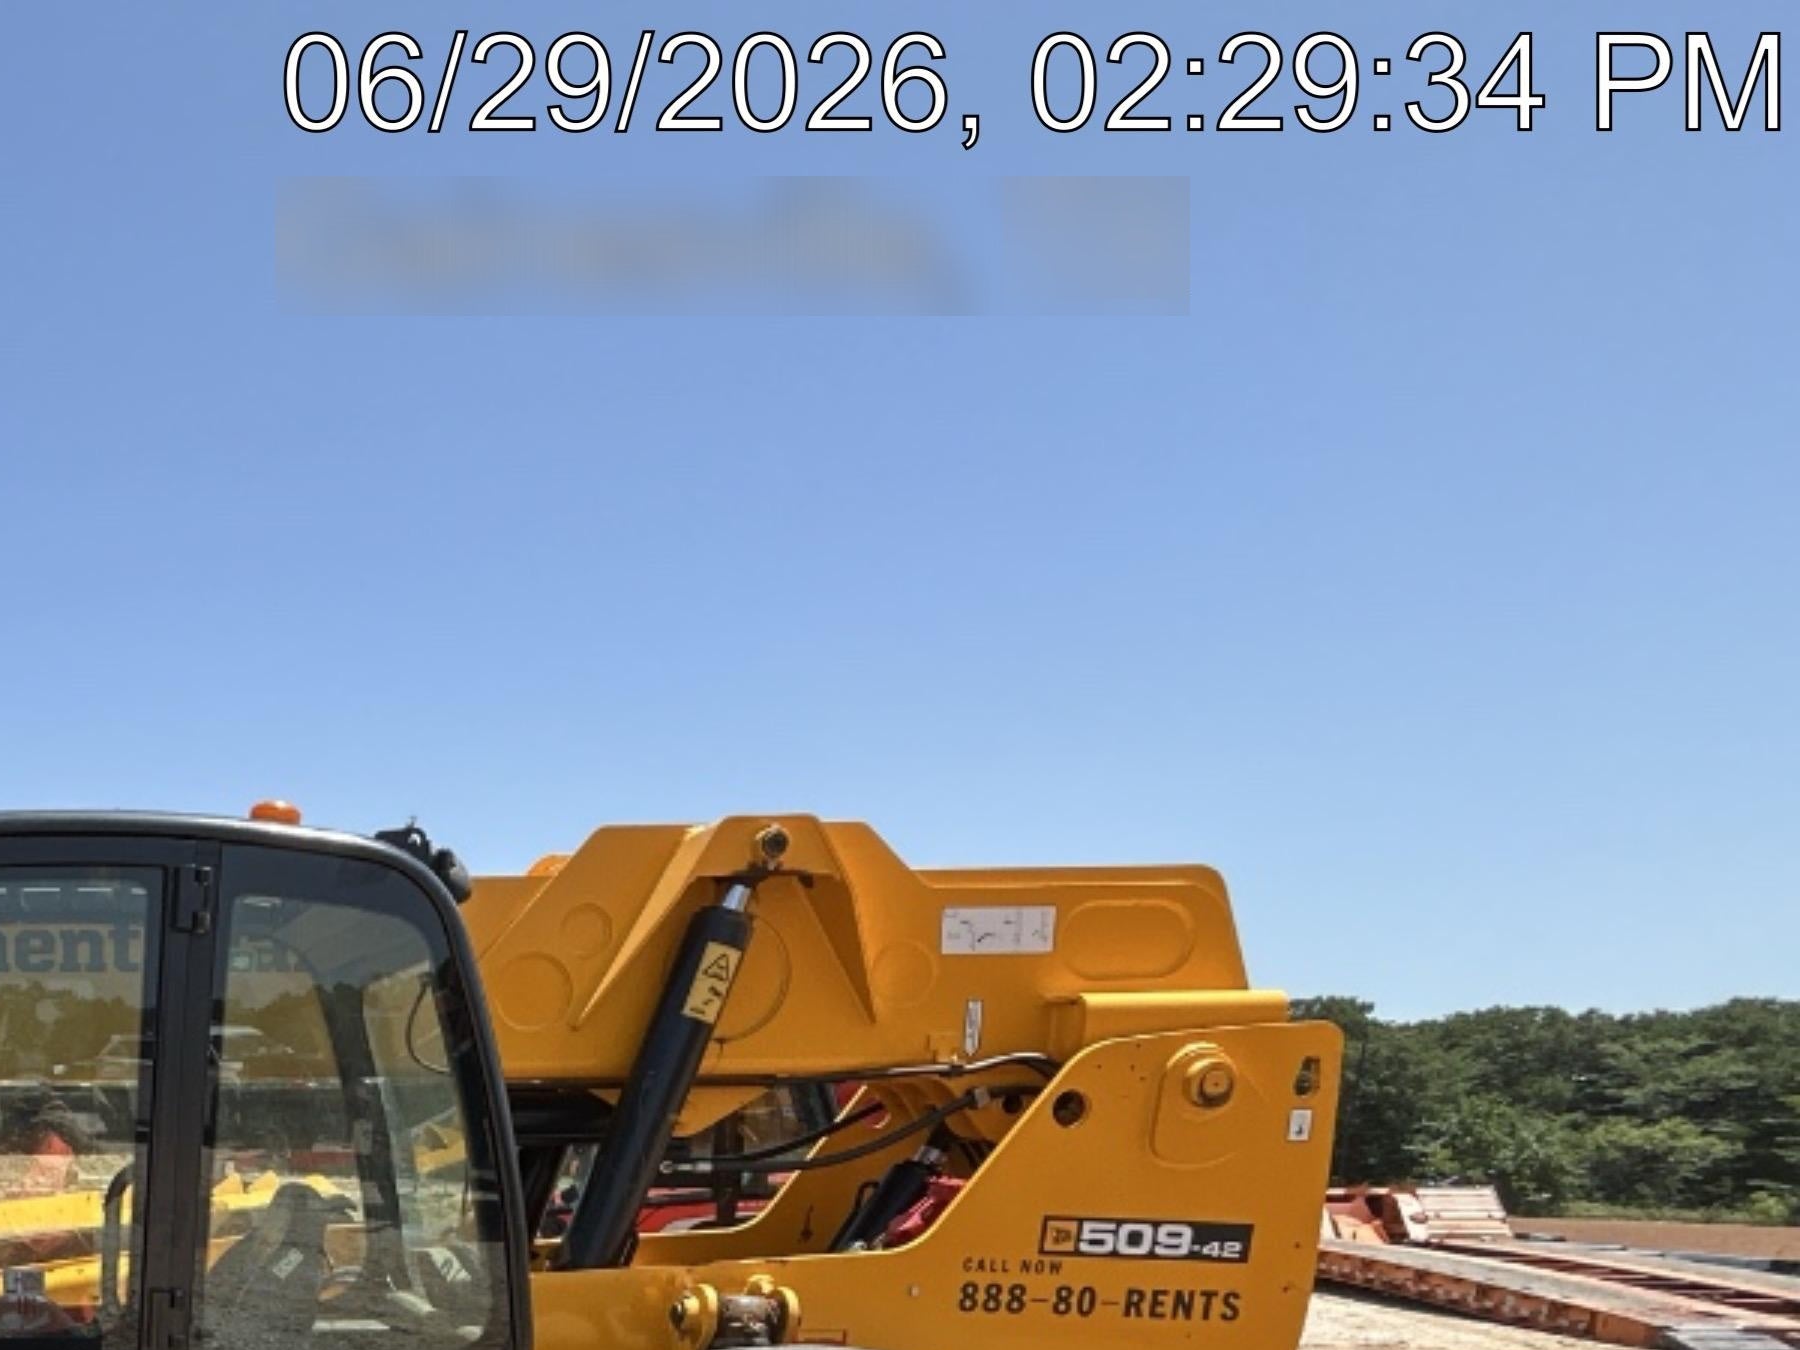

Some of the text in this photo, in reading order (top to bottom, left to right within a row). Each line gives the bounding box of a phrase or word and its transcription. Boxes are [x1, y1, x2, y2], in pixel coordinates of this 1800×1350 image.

[962, 1256, 1063, 1276] CALL NOW
[958, 1280, 1241, 1322] 888-80-RENTS
